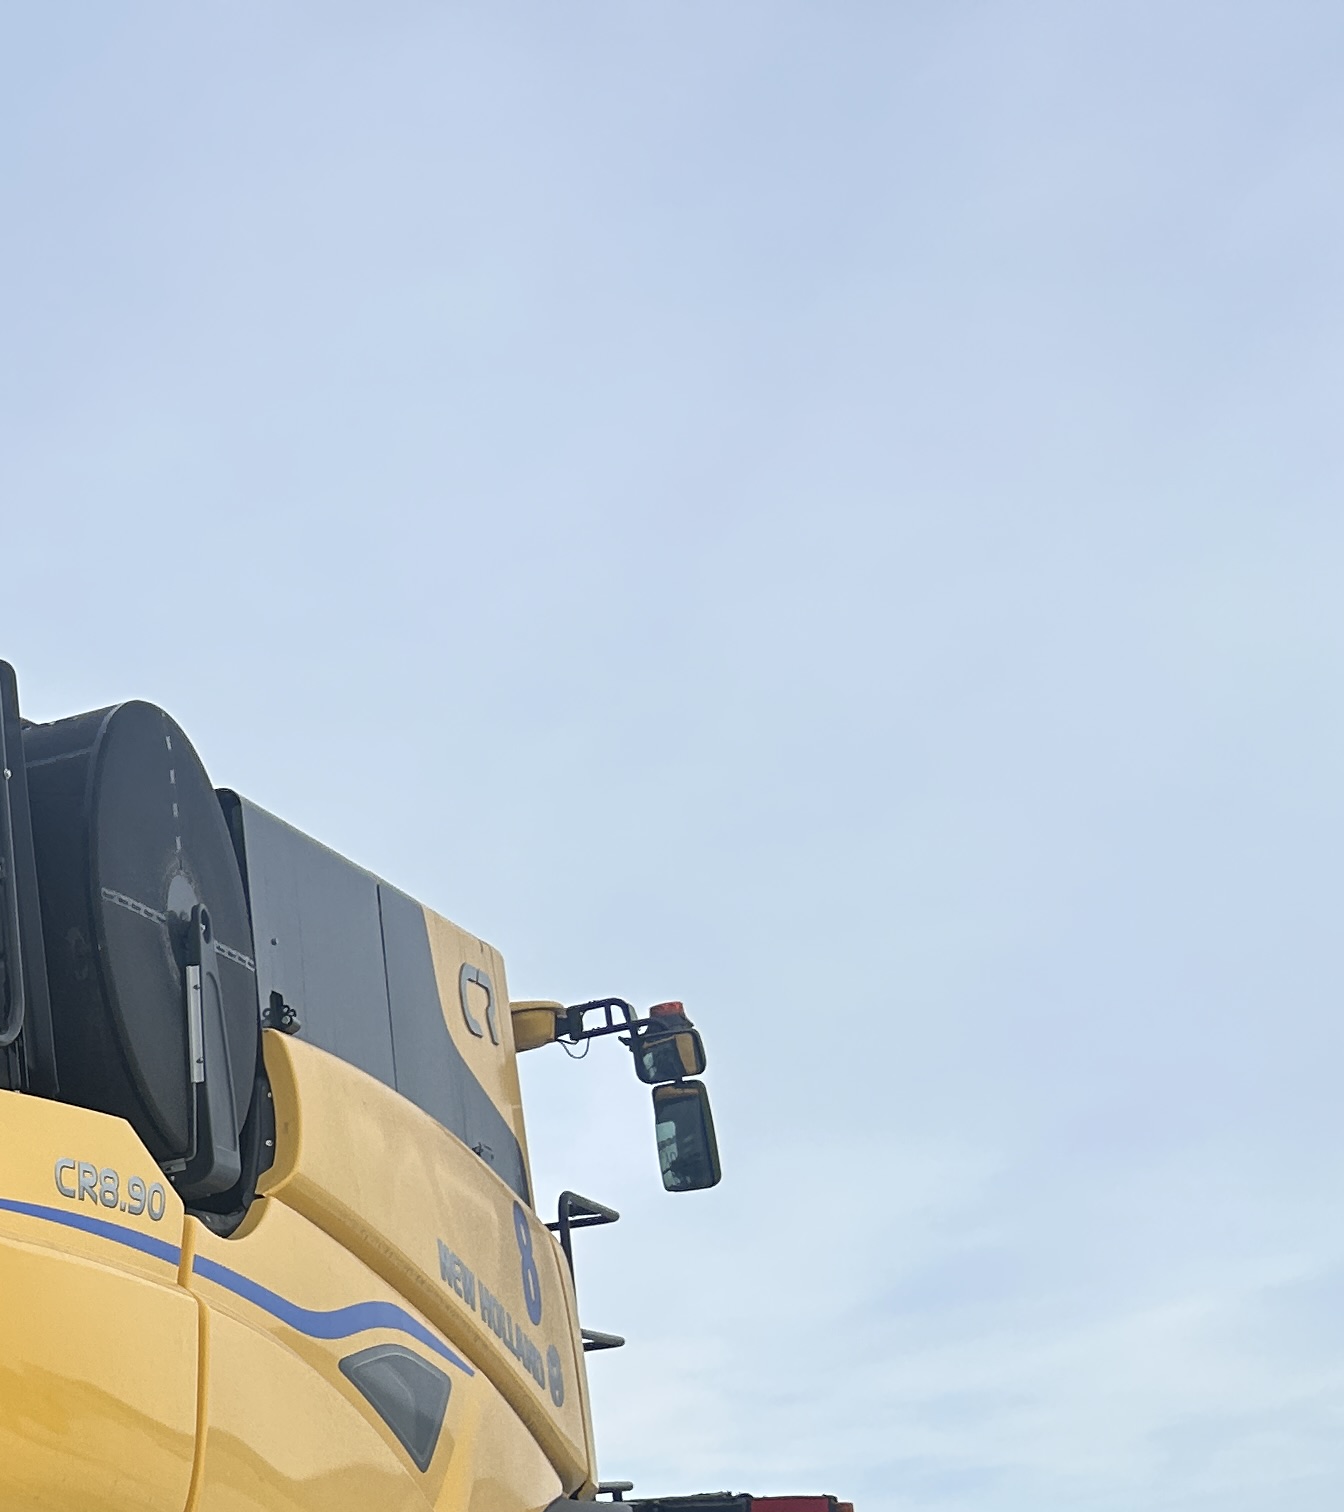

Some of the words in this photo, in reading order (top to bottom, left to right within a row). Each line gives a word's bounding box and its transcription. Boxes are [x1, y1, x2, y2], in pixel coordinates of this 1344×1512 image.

[55, 1157, 166, 1221] CR8.90
[437, 1237, 476, 1313] NEW
[478, 1279, 545, 1390] HOLLAND
[513, 1200, 541, 1326] 8
